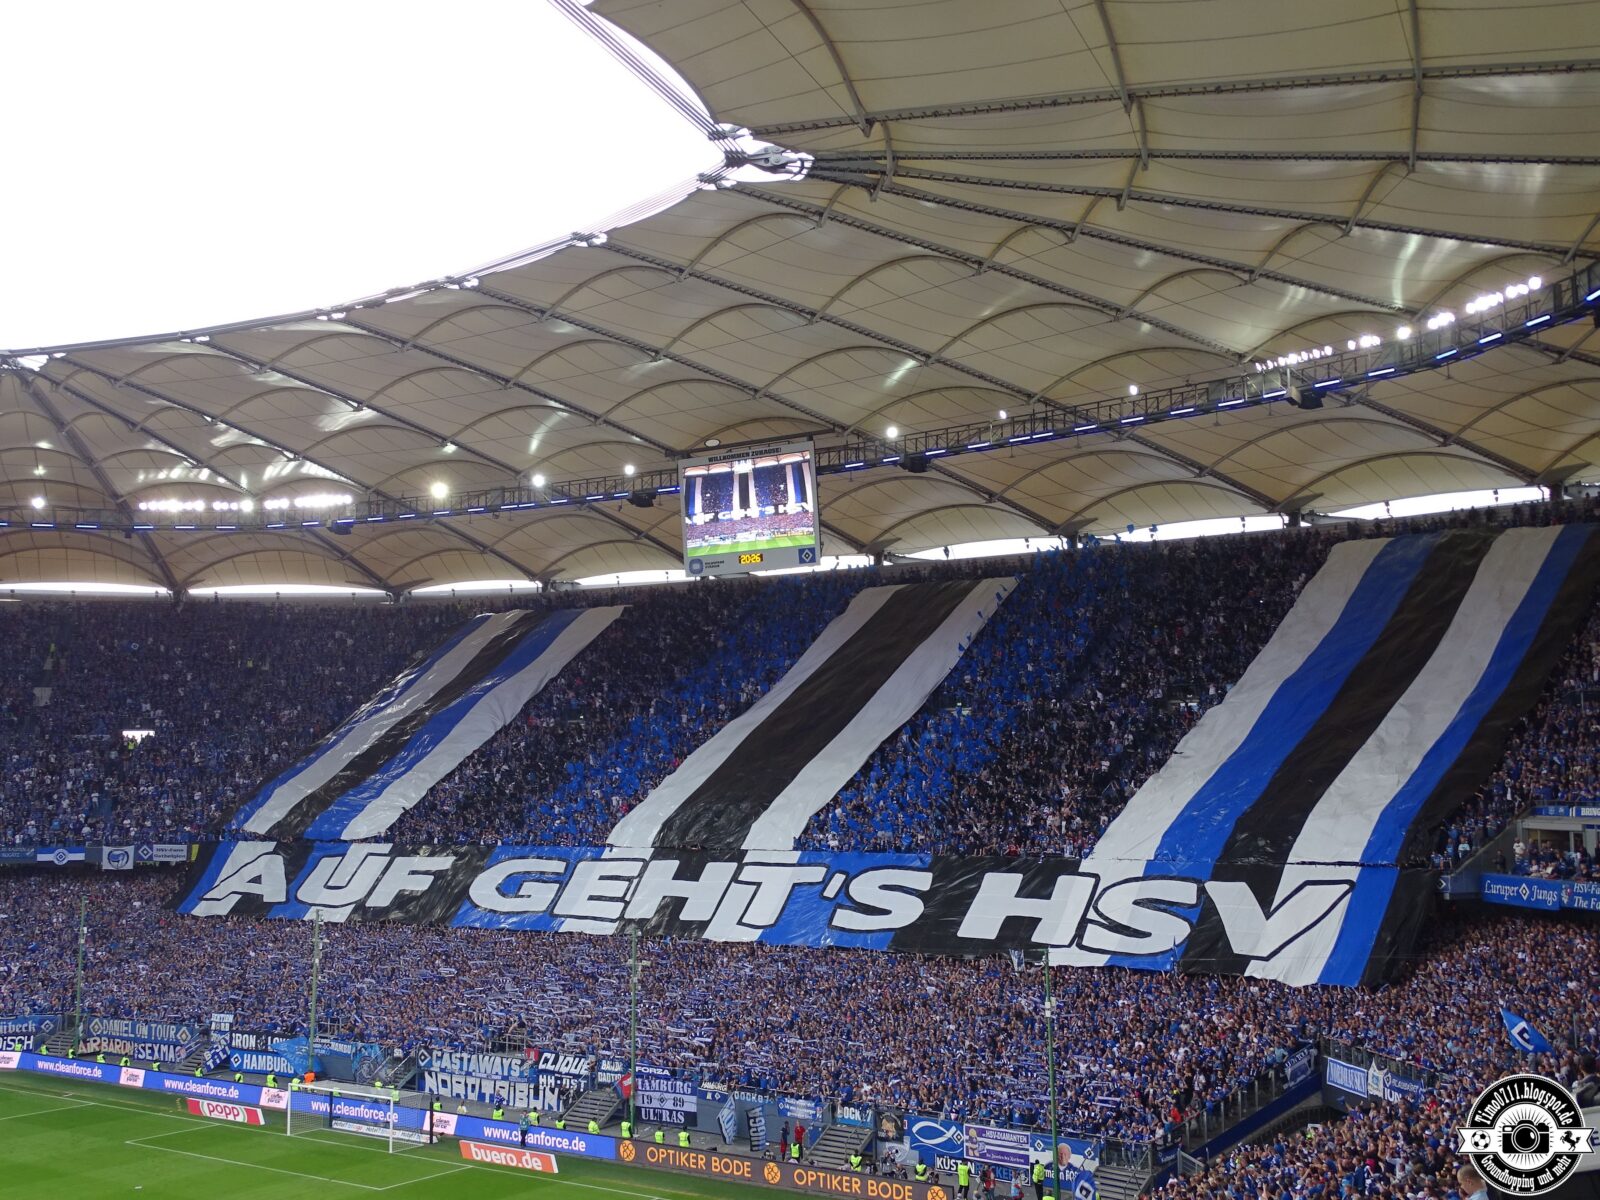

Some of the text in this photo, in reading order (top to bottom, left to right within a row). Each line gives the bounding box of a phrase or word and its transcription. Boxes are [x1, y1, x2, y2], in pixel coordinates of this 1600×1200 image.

[708, 452, 750, 463] WILLKOMMEN
[1531, 885, 1558, 905] Jungs
[202, 855, 1355, 959] AUF GEHT'S HSV
[103, 1020, 135, 1038] DANIEL
[150, 1023, 176, 1041] TOUR
[37, 1060, 103, 1078] www.cleanforce.de
[432, 1051, 521, 1077] CASTAWAYS
[635, 1066, 671, 1076] FORZA
[164, 1078, 240, 1099] www.cleanforce.de
[641, 1094, 685, 1108] 19 89
[207, 1102, 240, 1121] popp
[641, 1108, 685, 1124] ULTRAS
[470, 1144, 543, 1171] buero.de
[646, 1147, 752, 1177] OPTIKER BODE
[793, 1168, 913, 1200] OPTIKER BODE
